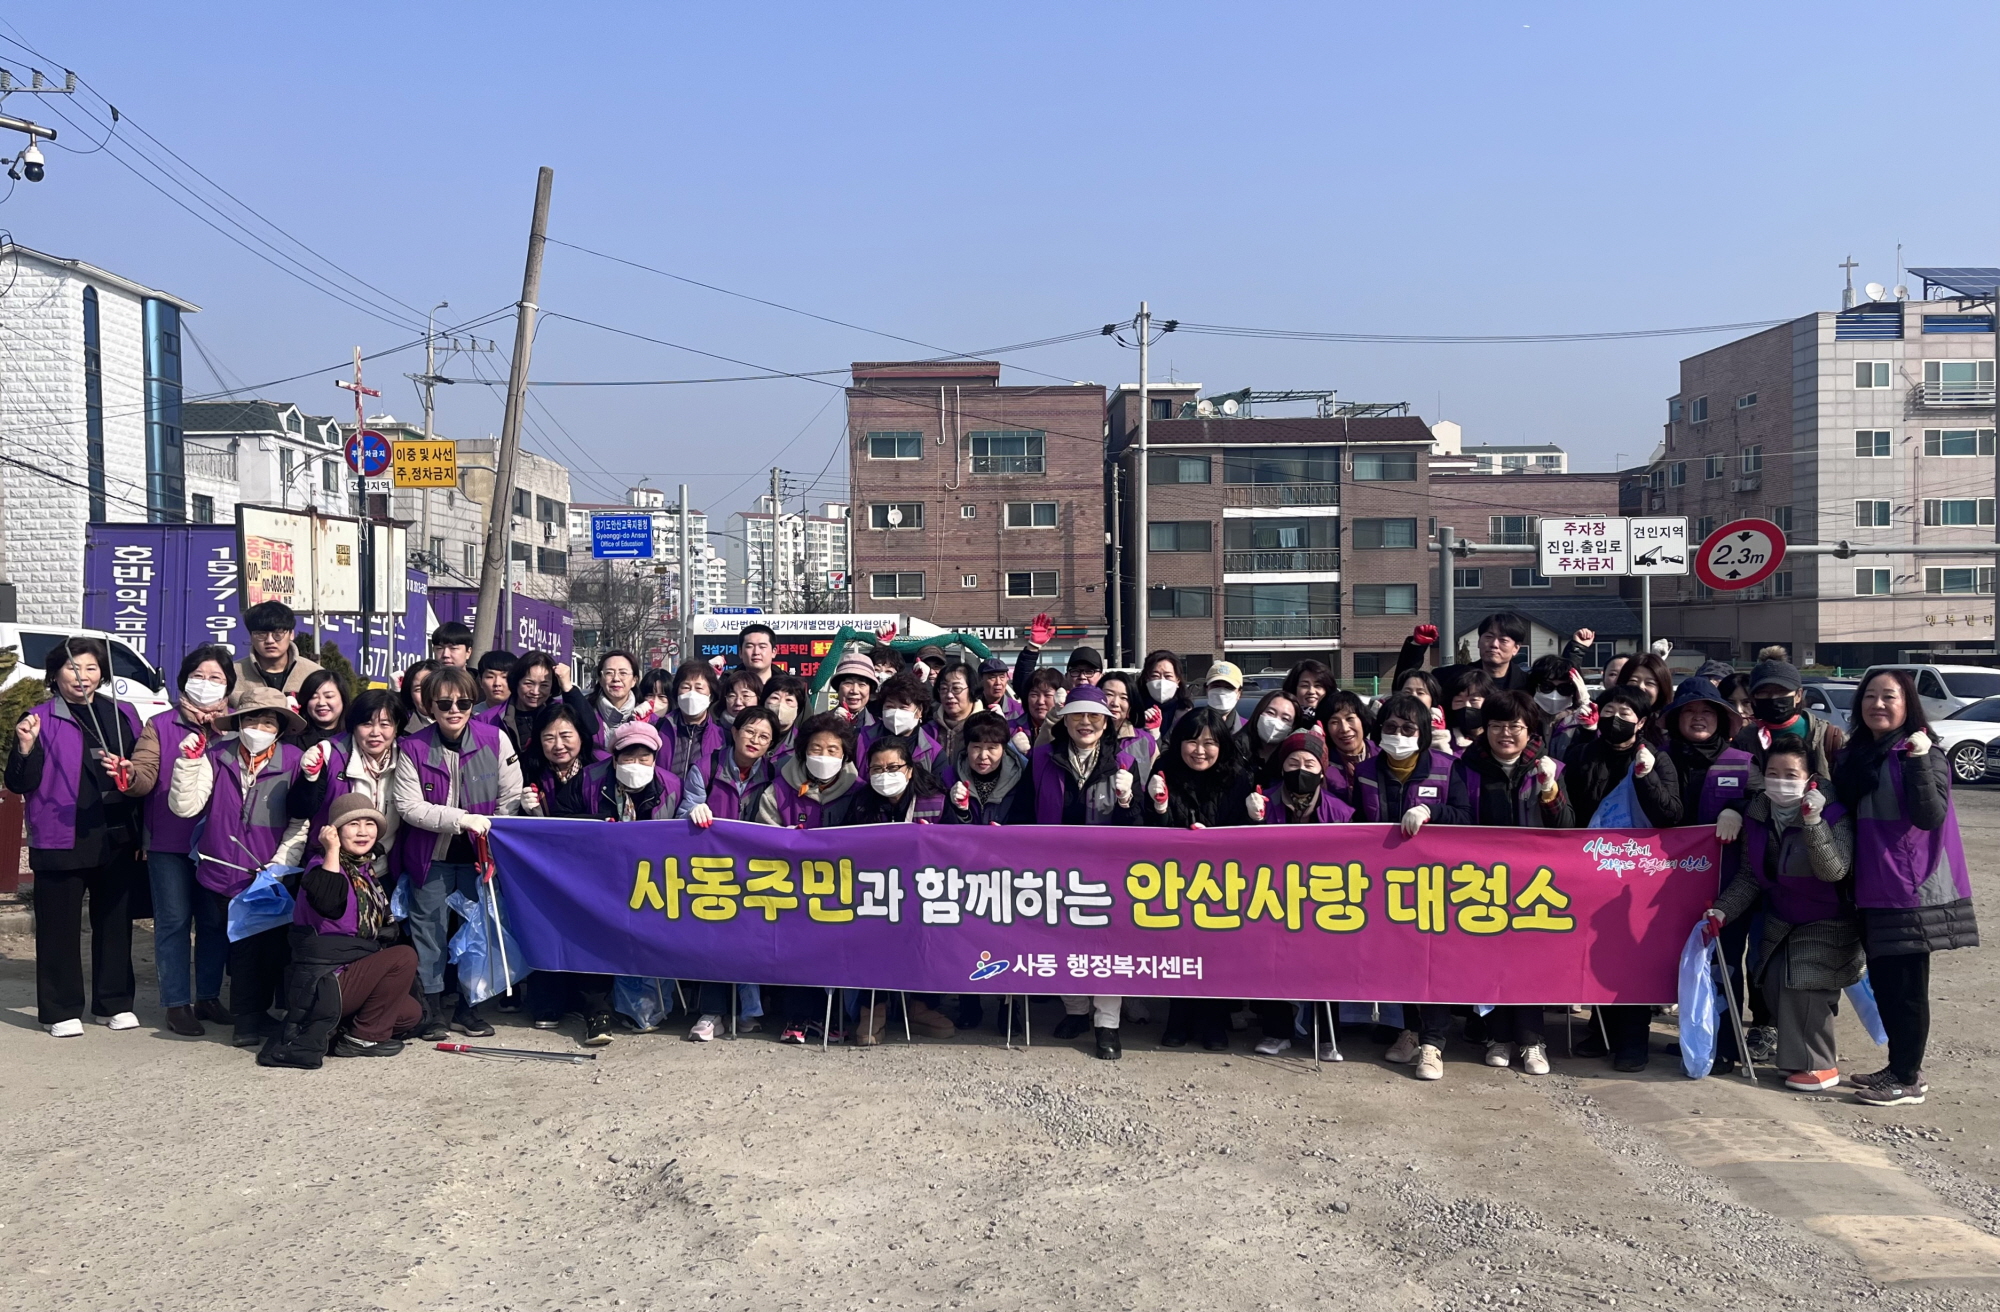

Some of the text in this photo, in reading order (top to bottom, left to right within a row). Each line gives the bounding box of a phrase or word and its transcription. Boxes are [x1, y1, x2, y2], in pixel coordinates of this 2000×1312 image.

[396, 447, 453, 461] 이중 및 사선
[396, 466, 454, 482] 주,정차금지
[594, 519, 648, 530] 경기도안산교육지원청
[596, 532, 630, 540] Gyeonggi-do
[1633, 526, 1684, 539] 견인지역
[1547, 540, 1622, 554] 진입.출입로
[1712, 545, 1765, 565] 2.3m
[1558, 556, 1614, 571] 주차금지
[701, 645, 738, 655] 건설기계
[1679, 855, 1712, 872] 안산
[629, 857, 1577, 934] 사동주민과 함께하는 안산사랑 대청소
[1012, 953, 1203, 979] 사동 행정복지센터
